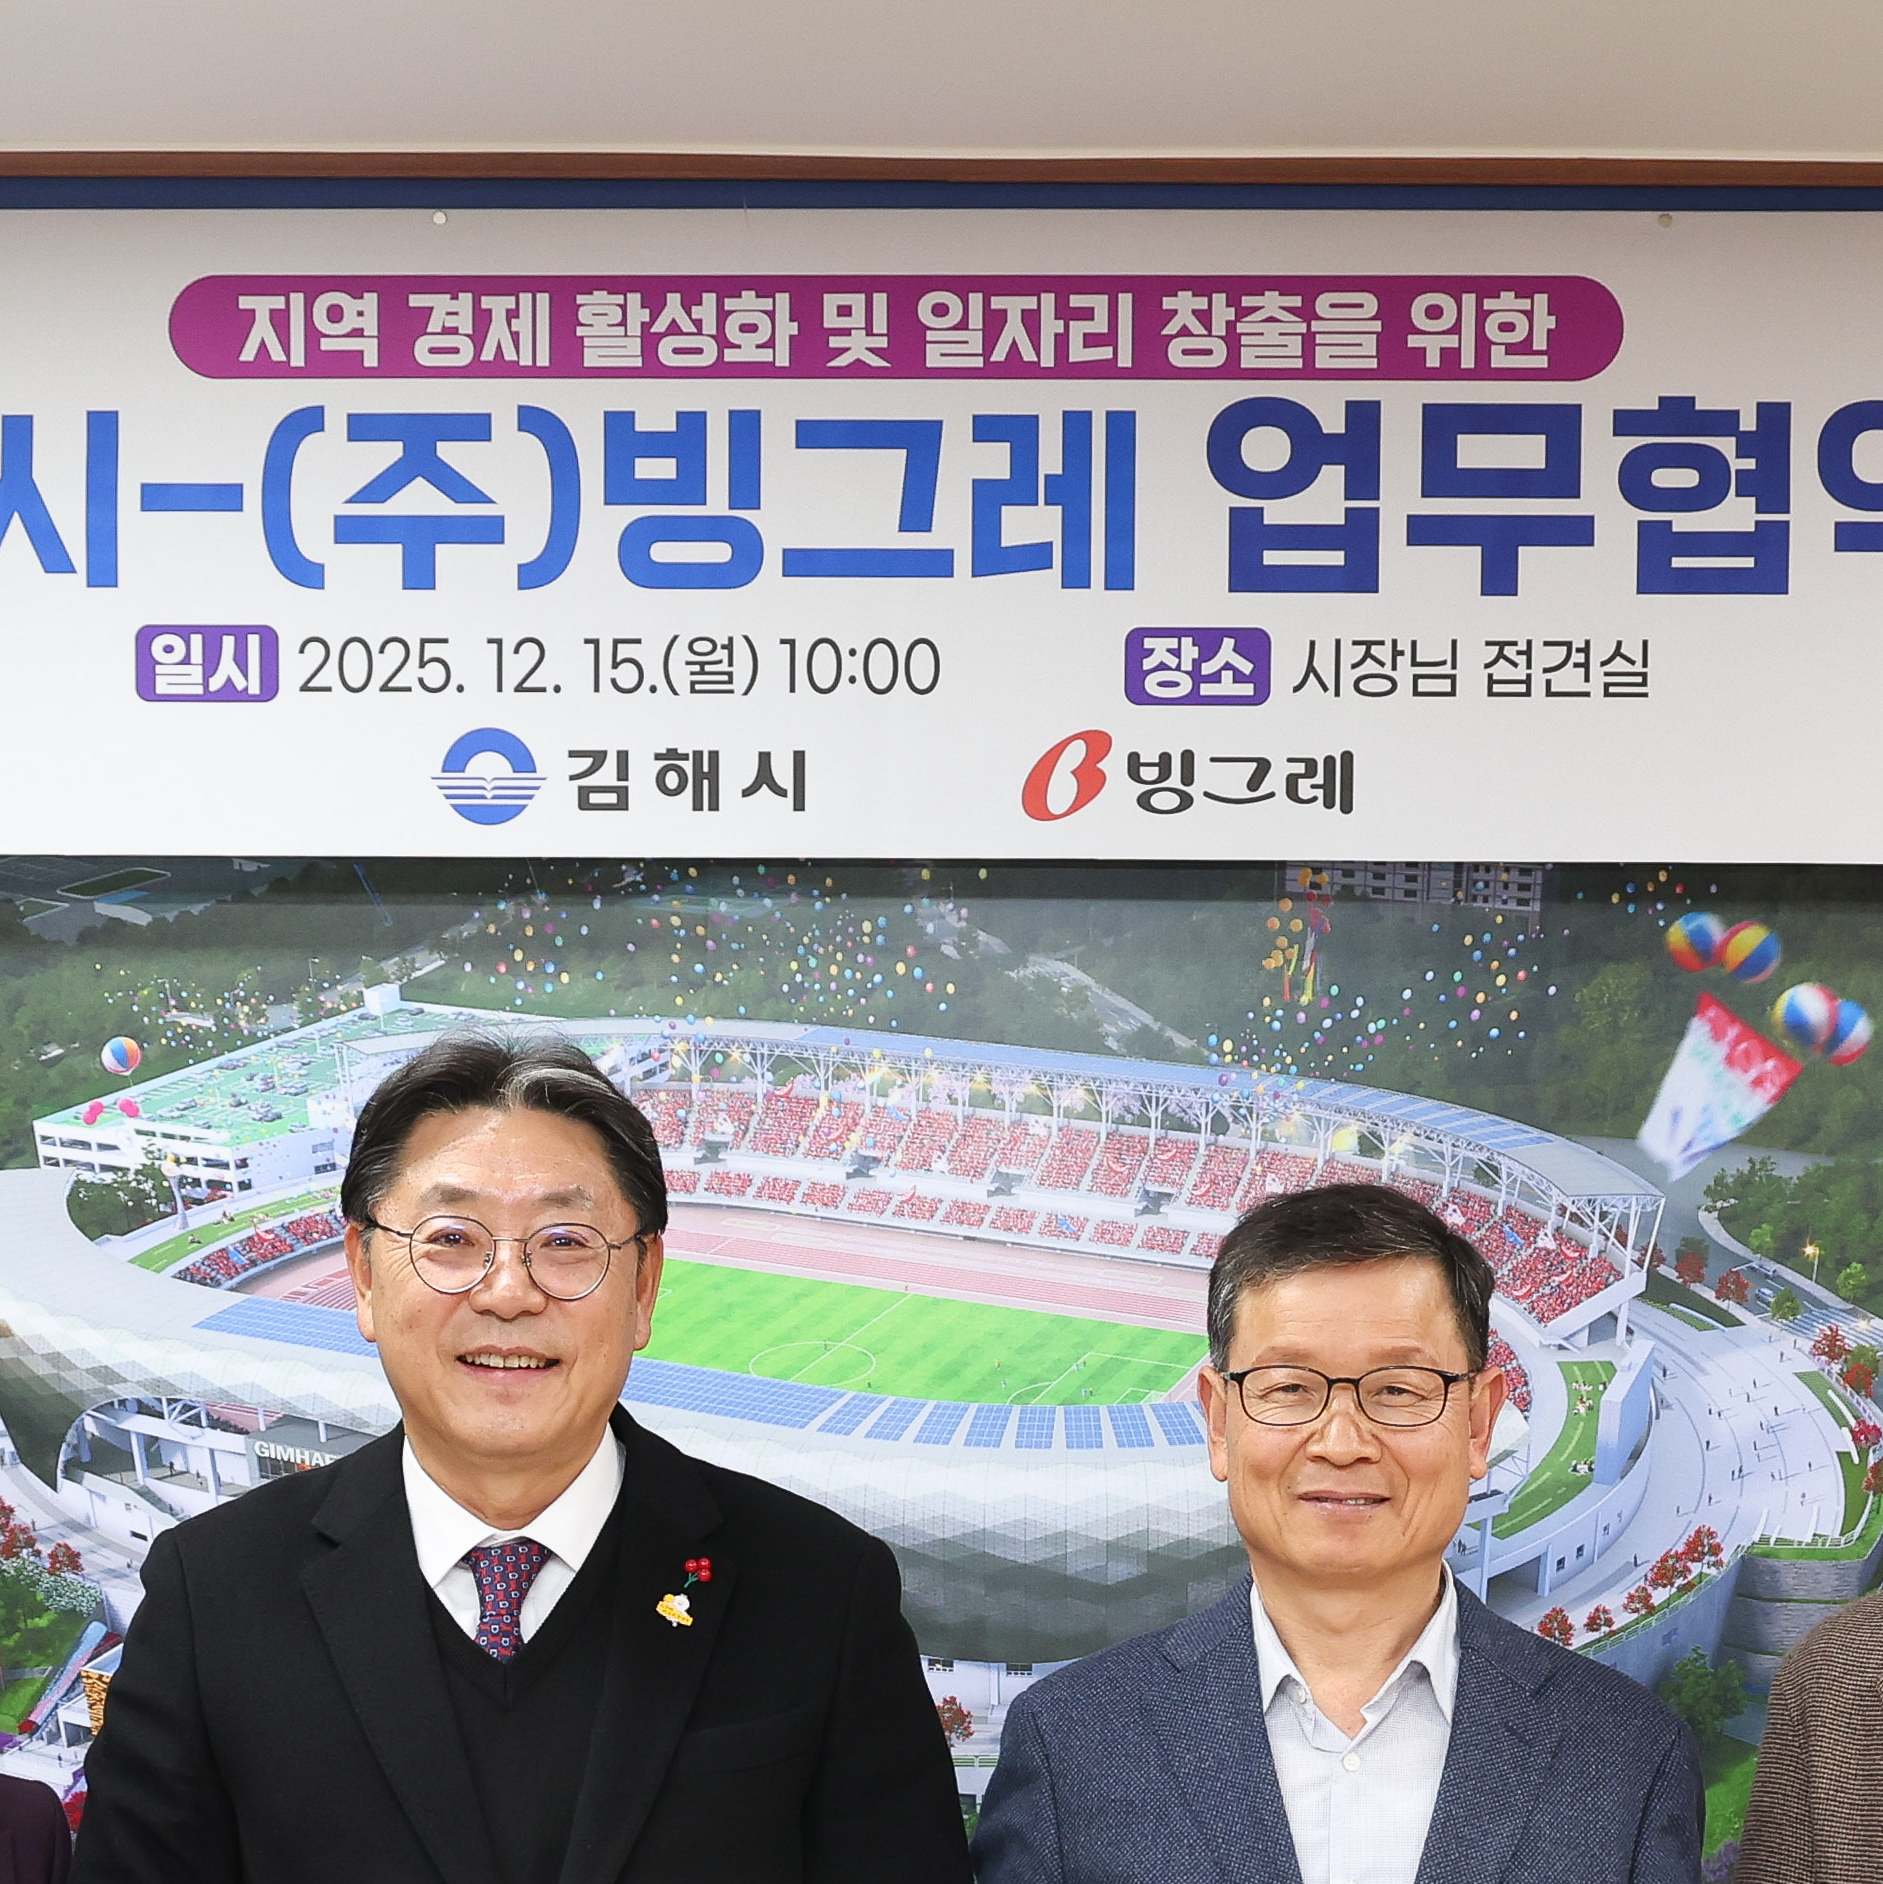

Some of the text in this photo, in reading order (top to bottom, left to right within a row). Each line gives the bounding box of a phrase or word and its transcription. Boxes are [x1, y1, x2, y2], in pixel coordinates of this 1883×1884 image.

[239, 291, 1556, 369] 지역 경제 활성화 및 일자리 창출을 위한
[150, 632, 941, 696] 일시 2025. 12. 15.(월) 10:00
[1141, 636, 1649, 699] 장소 시장님 접견실
[568, 748, 806, 812] 김해시
[1127, 749, 1354, 815] 빙그레
